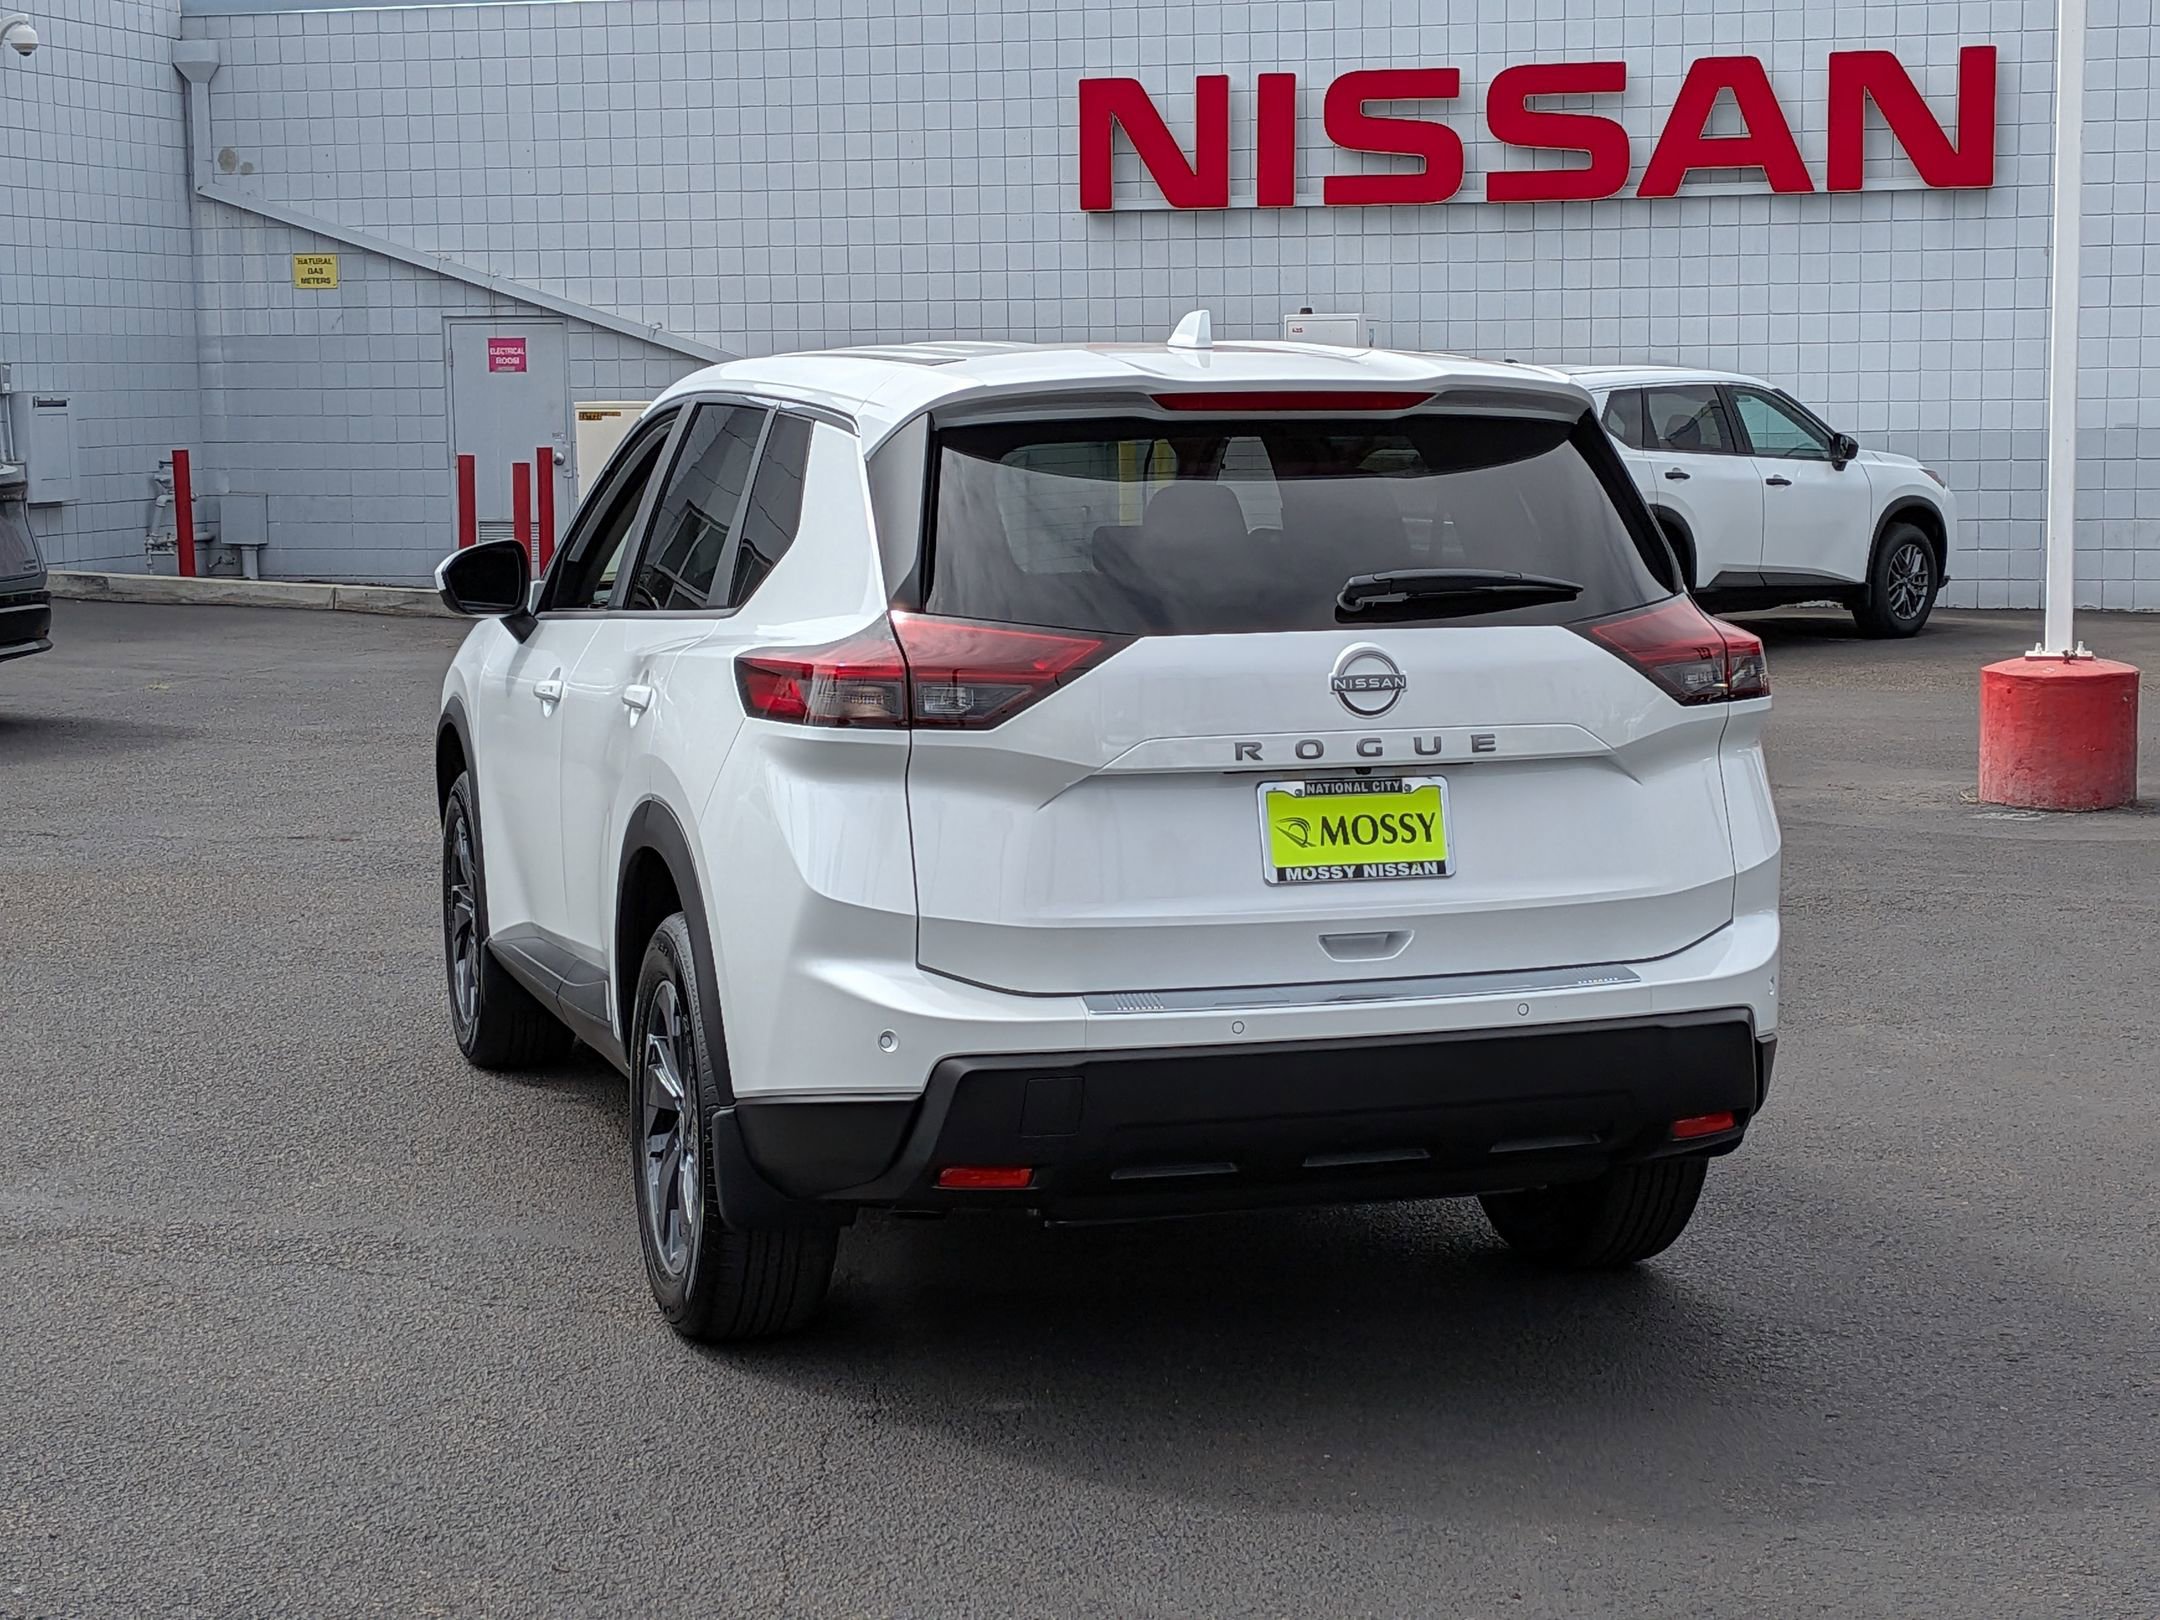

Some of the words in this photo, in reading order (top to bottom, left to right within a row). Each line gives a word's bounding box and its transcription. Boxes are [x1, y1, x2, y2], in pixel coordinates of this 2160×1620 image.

[1078, 45, 1998, 213] NISSAN
[297, 257, 333, 265] NATURAL
[307, 267, 324, 275] GAS
[300, 277, 332, 285] METERS
[489, 347, 525, 356] ELECTRICAL
[1333, 676, 1406, 690] NISSAN
[1234, 733, 1497, 762] ROGUE
[1306, 781, 1369, 795] NATIONAL
[1372, 779, 1401, 793] CITY
[1320, 811, 1436, 847] MOSSY
[1285, 864, 1356, 882] MOSSY
[1363, 861, 1439, 877] NISSAN
